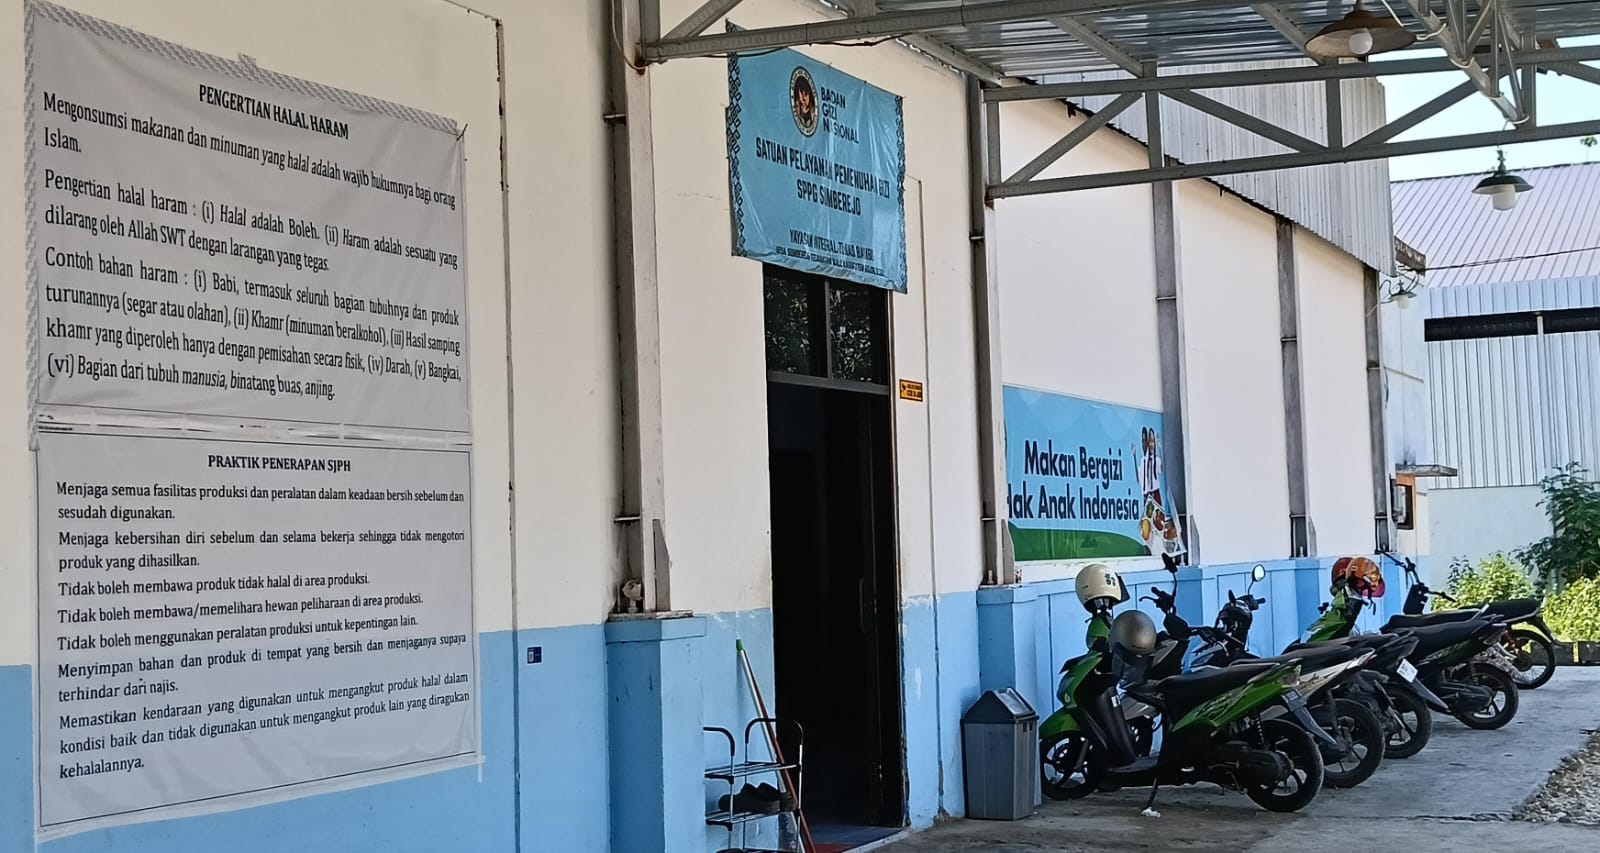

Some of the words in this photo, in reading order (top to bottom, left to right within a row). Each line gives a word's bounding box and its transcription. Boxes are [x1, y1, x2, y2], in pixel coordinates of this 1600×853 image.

[199, 84, 271, 120] PENGERTIAN
[273, 104, 310, 130] HALAL
[309, 114, 349, 140] HARAM
[821, 87, 846, 109] BADAN
[822, 103, 837, 120] GIZI
[44, 126, 82, 153] Islam.
[823, 118, 859, 144] NSIONAL
[43, 91, 128, 130] Mengonsumsi
[131, 116, 185, 143] makanan
[187, 126, 207, 148] dan
[210, 135, 260, 161] minuman
[260, 149, 286, 171] yang
[287, 150, 310, 173] halal
[311, 158, 341, 181] adalah
[342, 169, 370, 188] wajib
[370, 170, 414, 199] hukumnya
[415, 181, 432, 205] bagi
[433, 191, 456, 211] orang
[755, 136, 788, 166] SATUAN
[789, 148, 833, 180] PELAYANAN
[797, 179, 818, 203] SPPG
[45, 168, 111, 200] Pengertian
[117, 182, 145, 207] halal
[150, 189, 188, 215] haram
[220, 204, 247, 227] Halal
[251, 211, 284, 234] adalah
[288, 218, 320, 240] Boleh.
[342, 228, 370, 250] Haram
[373, 236, 402, 256] adalah
[405, 245, 436, 262] sesuatu
[45, 203, 98, 236] dilarang
[100, 214, 125, 237] oleh
[127, 219, 159, 242] Allah
[160, 225, 186, 247] SWT
[188, 229, 228, 257] dengan
[230, 237, 275, 265] larangan
[276, 250, 303, 271] yang
[303, 252, 329, 274] tegas.
[45, 246, 94, 271] Contoh
[98, 253, 134, 278] bahan
[140, 260, 178, 284] haram
[212, 272, 239, 296] Babi,
[244, 279, 293, 301] termasuk
[296, 286, 329, 307] seluruh
[333, 290, 365, 314] bagian
[369, 297, 409, 321] tubuhnya
[431, 308, 459, 327] produk
[45, 284, 120, 313] turunannya
[122, 291, 158, 318] (segar
[160, 300, 185, 318] atau
[187, 301, 231, 328] olahan),
[233, 307, 249, 331] (ii)
[251, 309, 284, 331] Khamr
[285, 314, 334, 337] (minuman
[406, 330, 427, 349] Hasil
[427, 337, 461, 357] samping
[46, 316, 93, 340] khamr
[95, 327, 123, 349] yang
[125, 325, 180, 351] diperoleh
[182, 332, 216, 358] hanya
[218, 337, 256, 362] dengan
[257, 345, 311, 365] pemisahan
[313, 352, 343, 368] secara
[345, 351, 365, 373] fisik,
[385, 356, 413, 377] Darah,
[428, 361, 461, 383] Bangkai,
[47, 352, 74, 379] (vi)
[77, 355, 118, 381] Bagian
[120, 359, 144, 380] dari
[146, 362, 179, 384] tubuh
[181, 370, 228, 391] manusia,
[230, 369, 276, 396] binatang
[276, 374, 303, 397] buas,
[304, 379, 335, 401] anjing.
[208, 455, 261, 469] PRAKTIK
[262, 457, 326, 471] PENERAPAN
[1024, 439, 1076, 478] Makan
[1079, 446, 1123, 490] Bergizi
[56, 481, 109, 499] Menjaga
[111, 486, 151, 497] semua
[153, 483, 197, 498] fasilitas
[198, 484, 248, 501] produksi
[271, 486, 317, 502] peralatan
[348, 488, 385, 501] keadaan
[414, 489, 448, 502] sebelum
[1037, 484, 1076, 519] Anak
[1079, 484, 1140, 520] Indonesia
[58, 504, 107, 519] sesudah
[110, 505, 175, 523] digunakan.
[59, 531, 109, 549] Menjaga
[114, 530, 181, 545] kebersihan
[210, 530, 255, 544] sebelum
[282, 530, 317, 543] selama
[320, 530, 355, 545] bekerja
[358, 530, 397, 545] sehingga
[425, 530, 465, 544] mengotori
[59, 554, 103, 573] produk
[105, 557, 136, 572] yang
[138, 553, 200, 568] dihasilkan.
[58, 581, 96, 596] Tidak
[97, 580, 130, 595] boleh
[133, 578, 193, 594] membawa
[196, 576, 236, 595] produk
[327, 572, 370, 589] produksi.
[57, 608, 97, 623] Tidak
[99, 606, 130, 622] boleh
[133, 601, 263, 620] membawa/memelihara
[265, 599, 298, 613] hewan
[300, 597, 350, 614] peliharaan
[384, 592, 423, 608] produksi.
[57, 634, 96, 651] Tidak
[99, 632, 131, 648] boleh
[134, 628, 214, 647] menggunakan
[216, 625, 267, 643] peralatan
[269, 621, 313, 639] produksi
[315, 619, 343, 633] untuk
[344, 617, 398, 633] kepentingan
[58, 661, 133, 680] Menyimpan
[138, 656, 174, 671] bahan
[207, 650, 247, 669] produk
[267, 647, 302, 662] tempat
[333, 640, 363, 654] bersih
[387, 637, 437, 650] menjaganya
[58, 684, 121, 703] terhindar
[123, 681, 147, 696] dari
[149, 679, 179, 695] najis.
[59, 709, 136, 730] Memastikan
[143, 704, 202, 720] kendaraan
[207, 701, 235, 716] yang
[238, 692, 292, 710] digunakan
[296, 687, 325, 703] untuk
[328, 681, 384, 699] mengangkut
[388, 677, 418, 695] produk
[60, 735, 105, 754] kondisi
[110, 731, 138, 748] baik
[168, 724, 197, 741] tidak
[199, 718, 257, 737] digunakan
[259, 712, 290, 729] untuk
[293, 706, 351, 725] mengangkut
[353, 700, 386, 720] produk
[428, 691, 470, 707] diragukan
[59, 758, 145, 779] kehalalannya.
